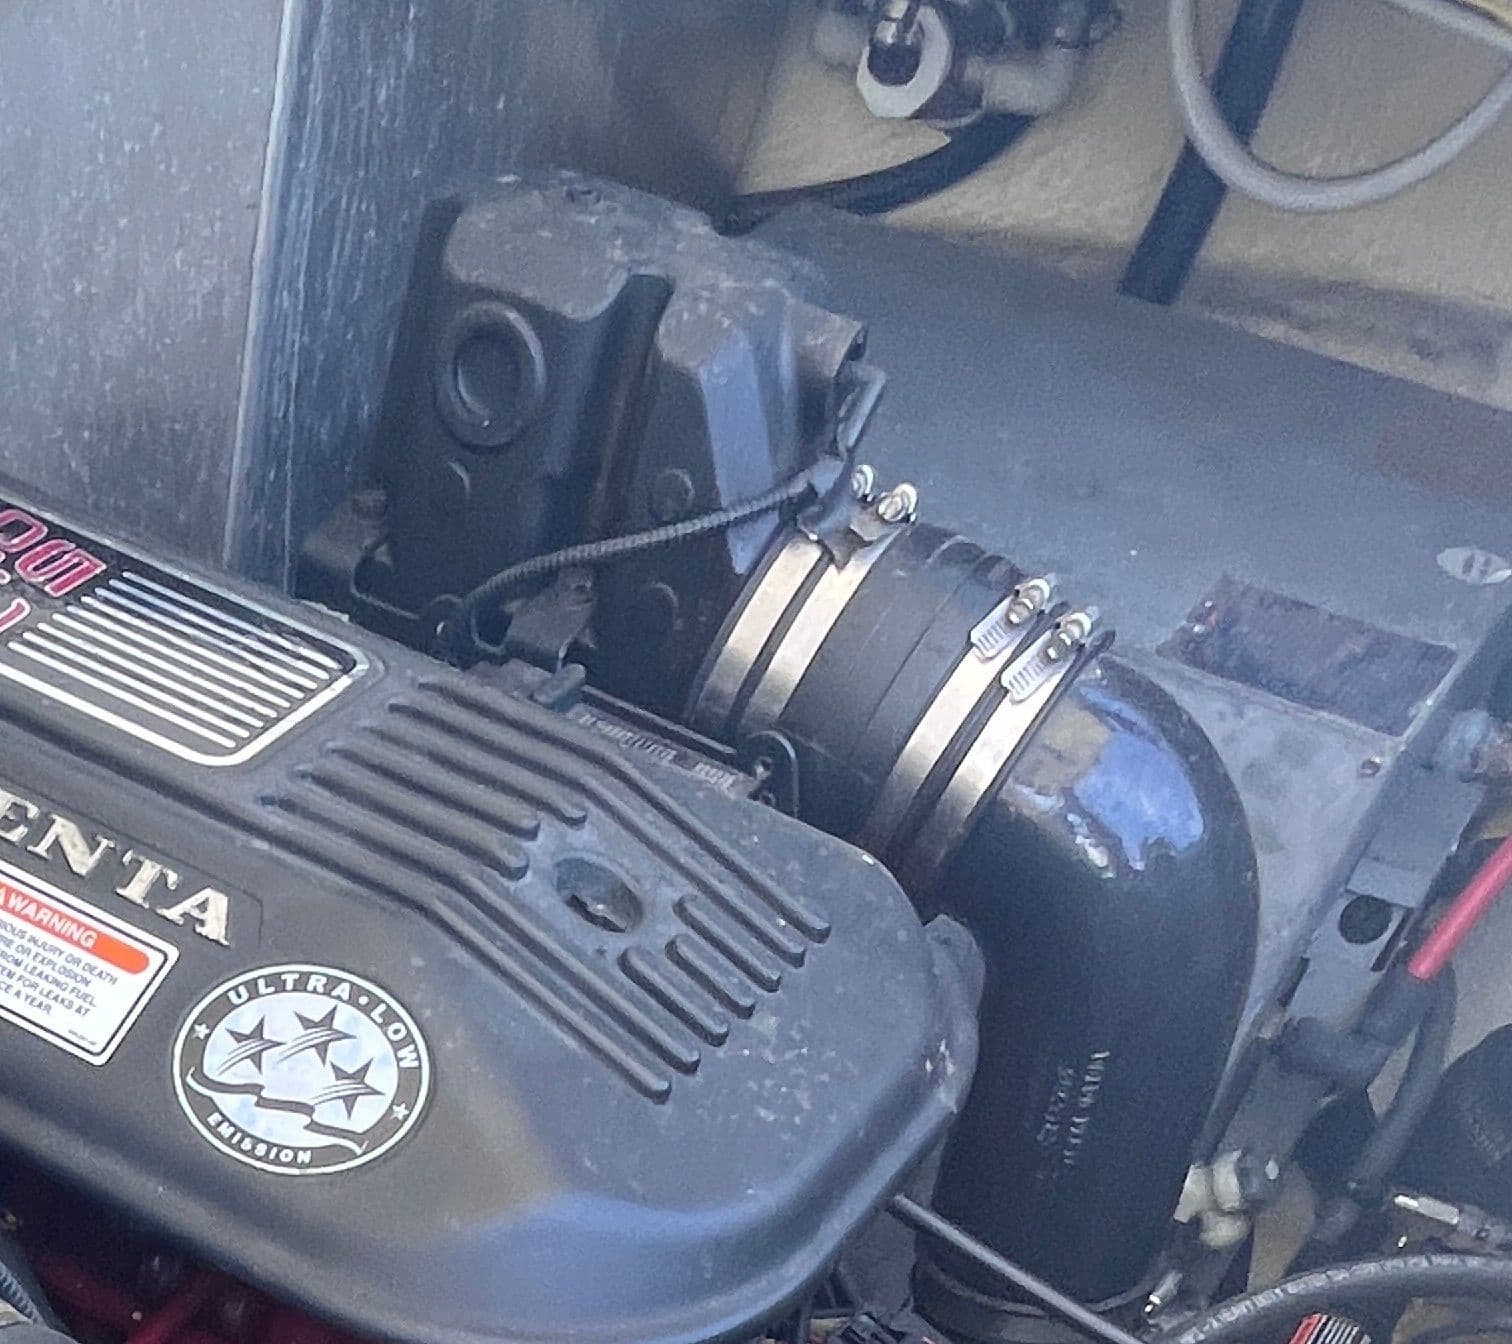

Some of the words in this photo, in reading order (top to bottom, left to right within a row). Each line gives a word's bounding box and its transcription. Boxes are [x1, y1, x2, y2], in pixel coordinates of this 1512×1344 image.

[6, 889, 98, 949] WARNING
[15, 941, 33, 960] OR
[27, 933, 65, 958] INJURY
[64, 951, 82, 967] OR
[82, 960, 119, 986] DEATH
[16, 973, 41, 993] FOR
[40, 985, 75, 1010] LEAKS
[74, 1002, 91, 1018] AT
[23, 962, 69, 992] LEAKING
[206, 1112, 312, 1164] EMISSION
